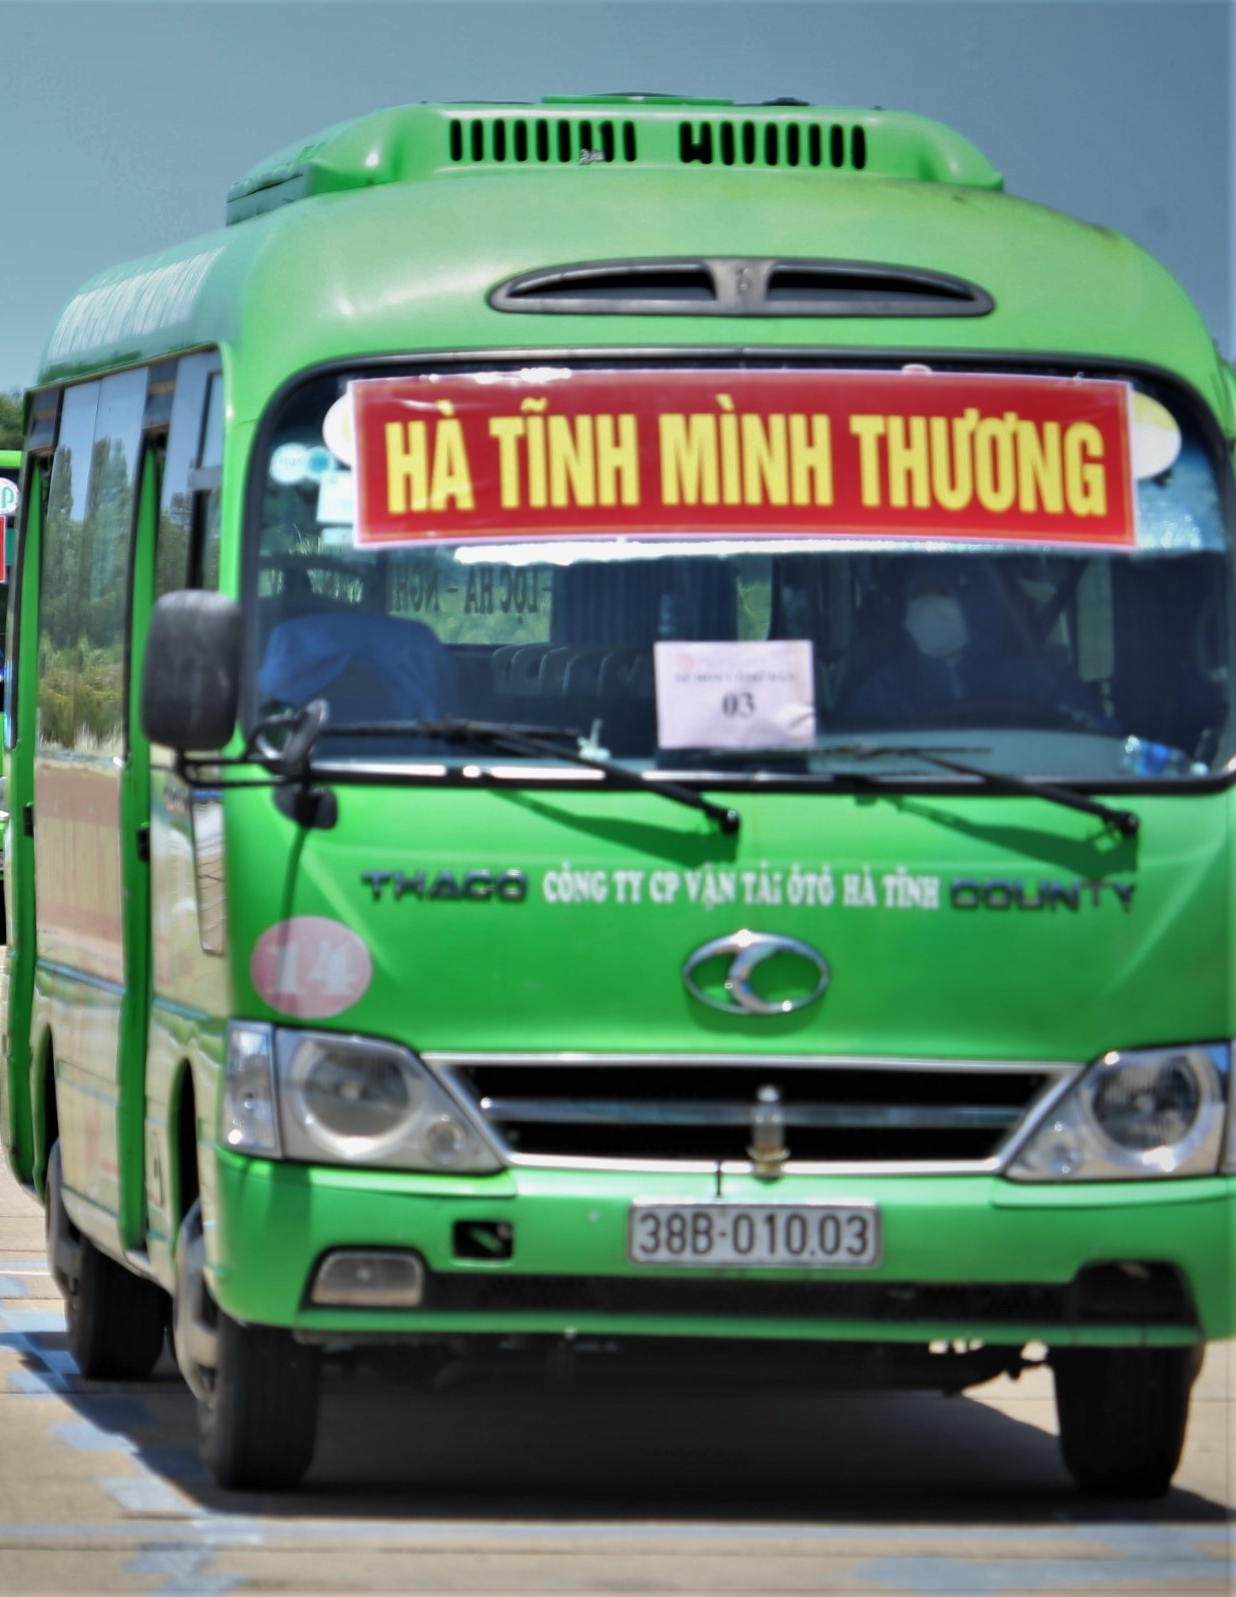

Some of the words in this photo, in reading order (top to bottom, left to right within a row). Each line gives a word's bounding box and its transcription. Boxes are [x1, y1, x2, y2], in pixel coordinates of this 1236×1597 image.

[385, 399, 475, 514] HÀ
[488, 397, 640, 509] TĨNH
[659, 393, 833, 507] MÌNH
[849, 408, 1108, 517] THƯƠNG
[721, 691, 755, 716] 03
[360, 868, 528, 902] THACO
[543, 859, 609, 903] CÔNG
[613, 869, 644, 903] TY
[649, 869, 680, 903] CP
[685, 861, 736, 911] VẬN
[843, 863, 877, 908] HÀ
[882, 865, 940, 909] TĨNH
[950, 876, 1136, 913] COUNTY
[265, 940, 359, 996] 14
[638, 1211, 869, 1257] 38B-010.03
